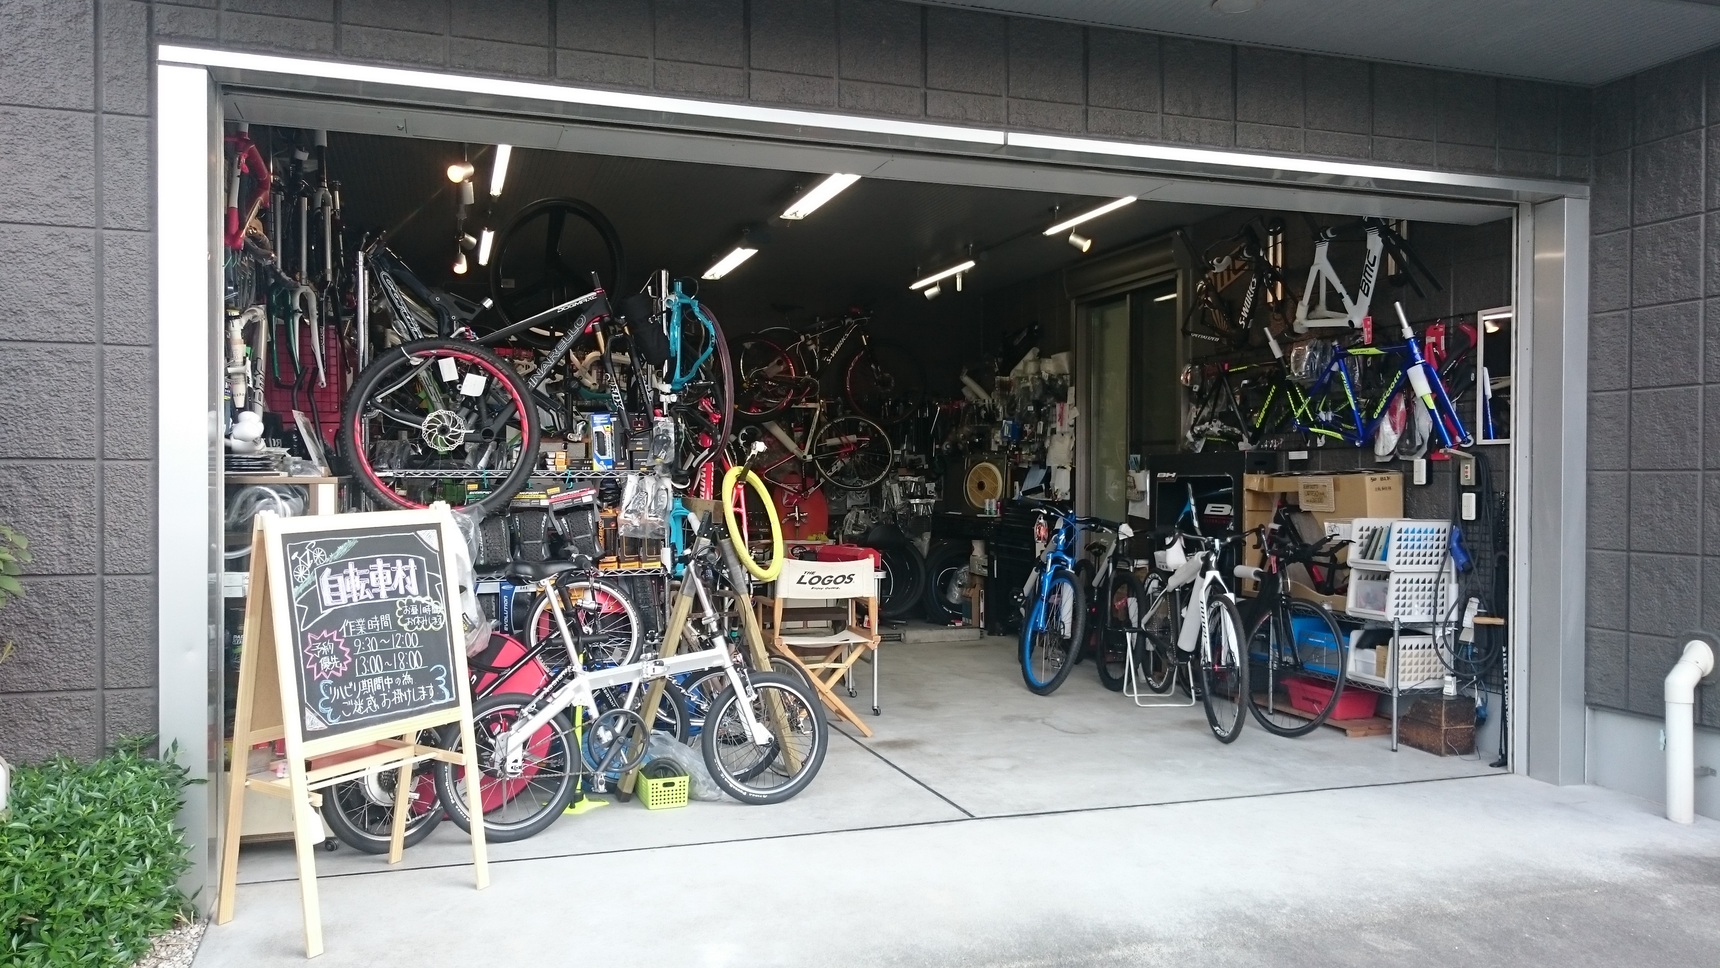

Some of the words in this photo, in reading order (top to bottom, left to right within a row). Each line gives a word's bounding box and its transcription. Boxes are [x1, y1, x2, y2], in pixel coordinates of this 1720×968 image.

[1361, 249, 1377, 297] BMC
[1239, 276, 1257, 329] S-WORKS
[527, 315, 586, 388] INARELLO
[319, 558, 419, 606] 自転車村
[796, 574, 855, 585] LOGOS
[339, 614, 392, 637] 作業時間
[312, 640, 334, 657] 予約
[320, 656, 342, 671] 優先
